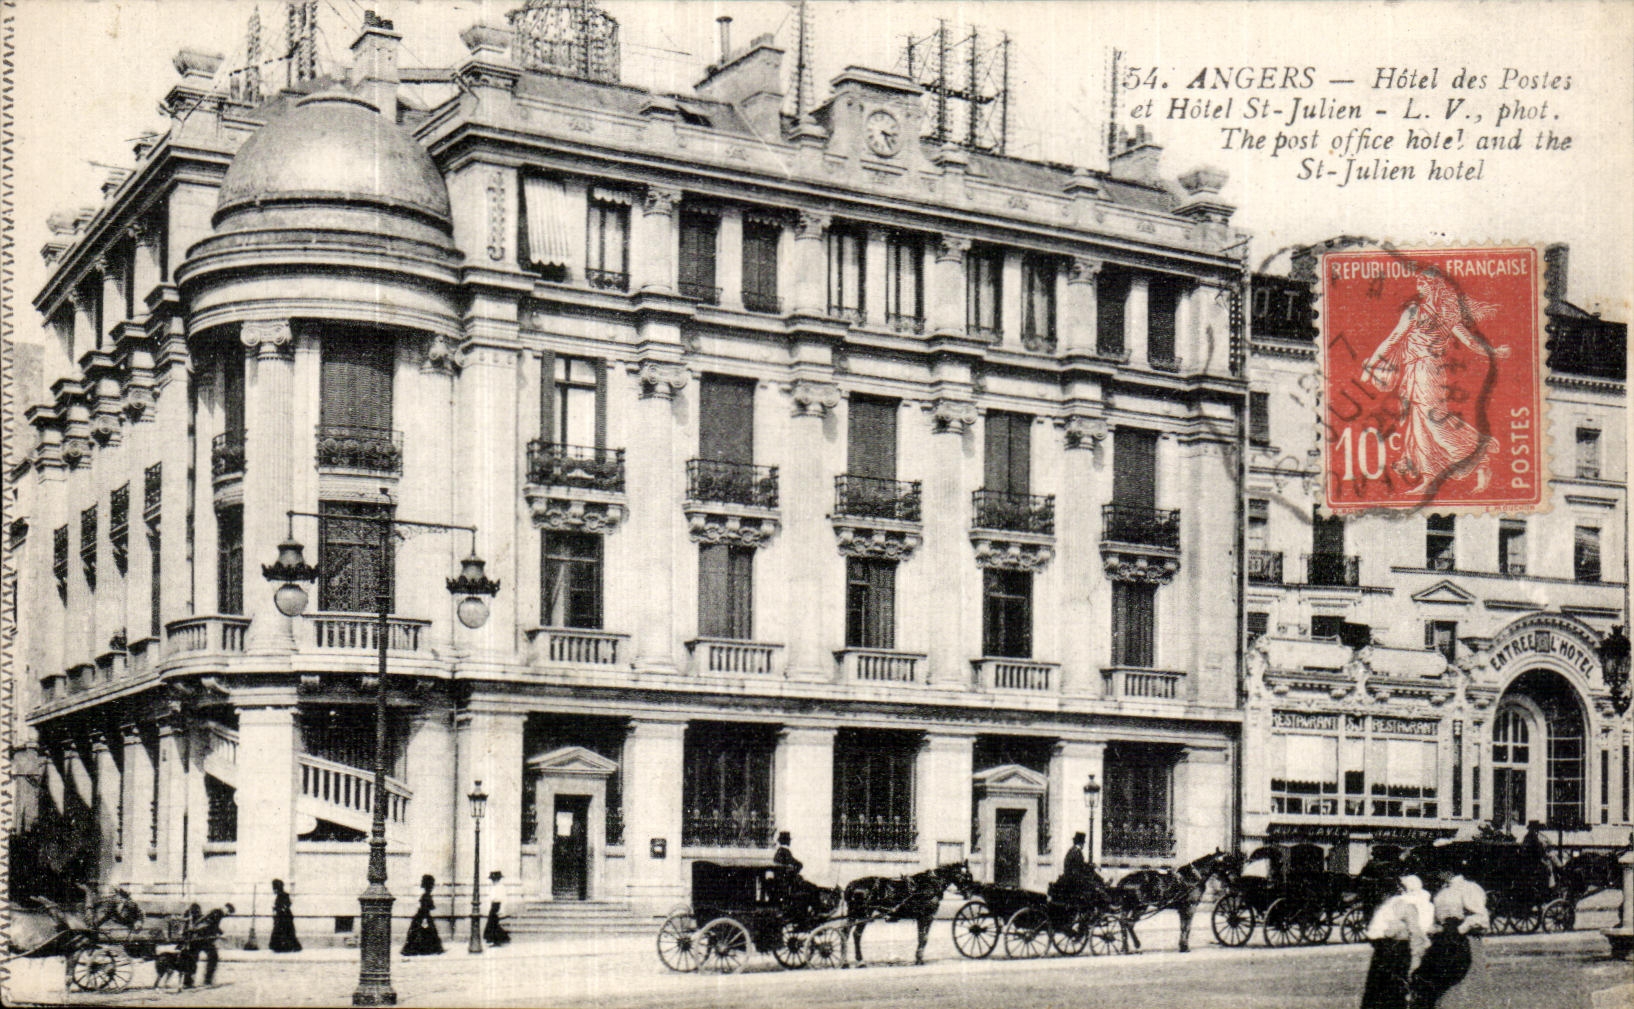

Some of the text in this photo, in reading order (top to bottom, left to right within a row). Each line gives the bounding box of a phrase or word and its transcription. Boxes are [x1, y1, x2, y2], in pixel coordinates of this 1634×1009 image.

[1445, 258, 1529, 277] FRANÇAISE
[1510, 405, 1531, 490] POSTES
[1489, 634, 1537, 671] ENTREE
[1272, 712, 1338, 730] RESTAURANT
[1372, 718, 1438, 736] RESTAURANT
